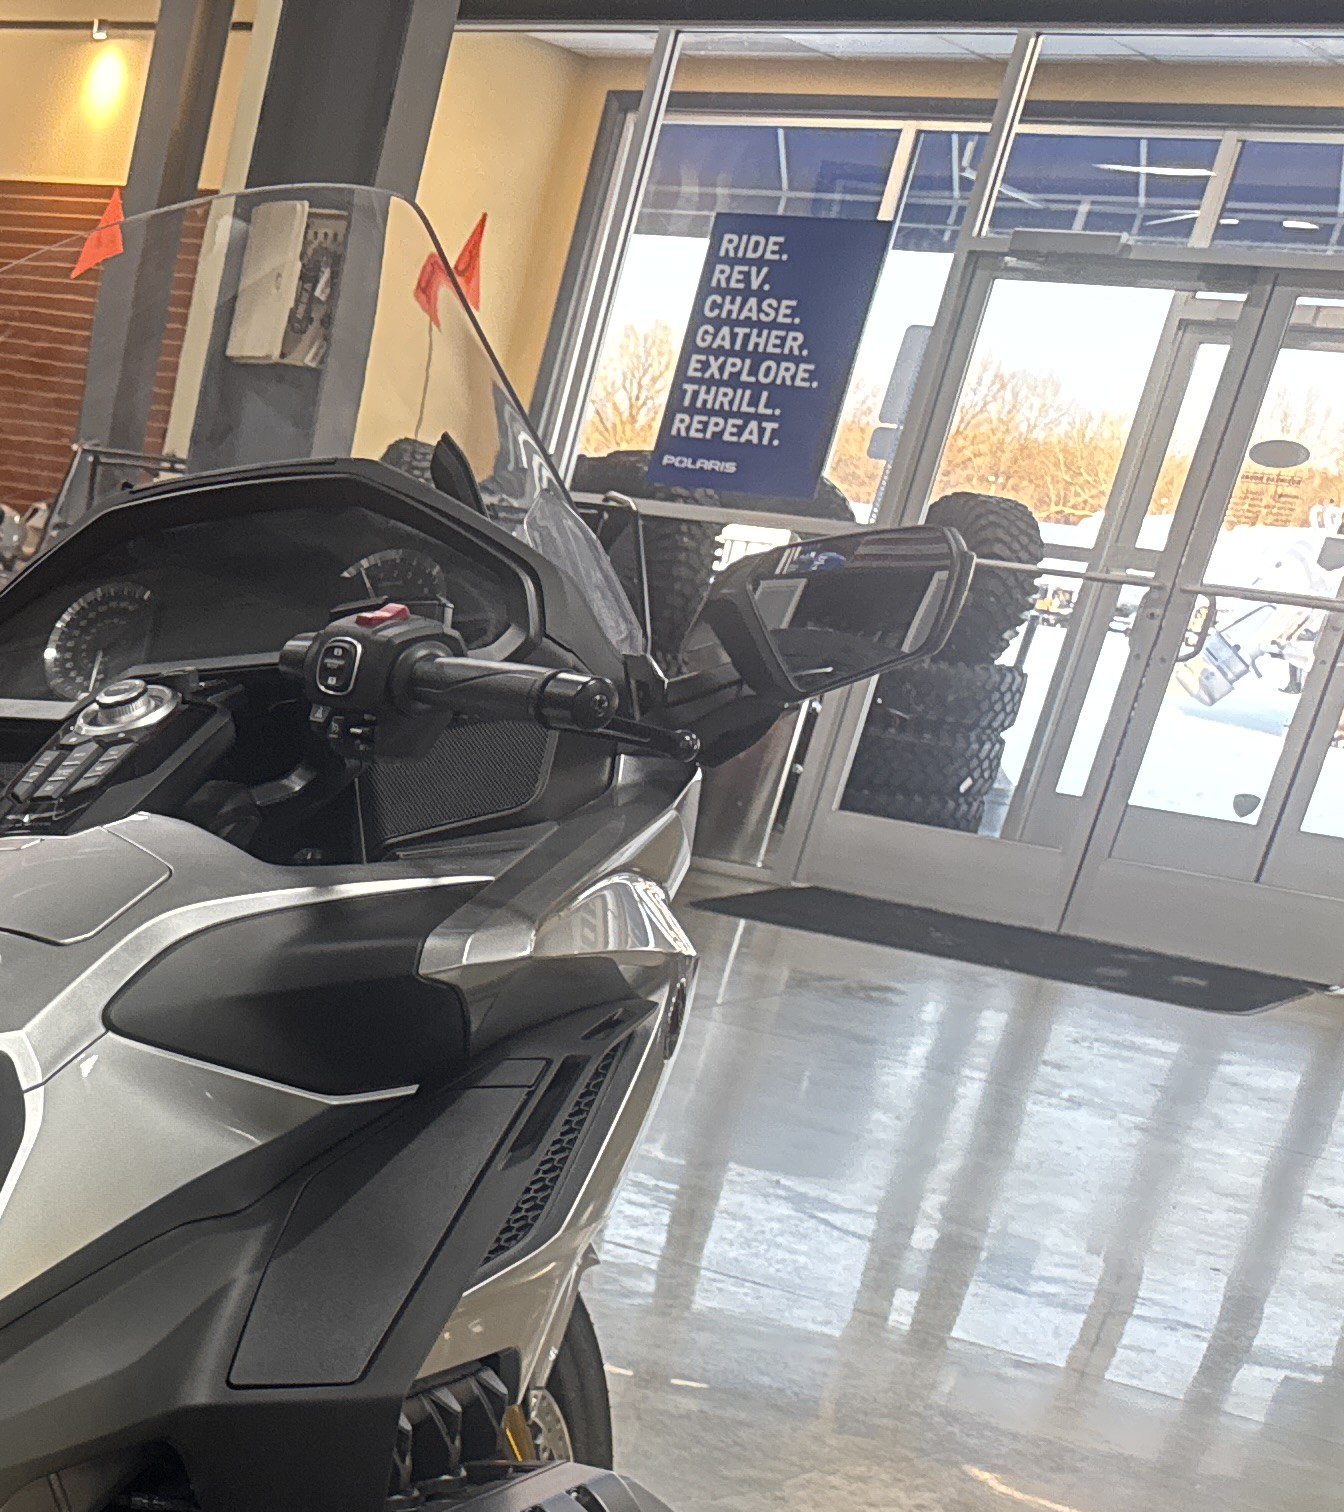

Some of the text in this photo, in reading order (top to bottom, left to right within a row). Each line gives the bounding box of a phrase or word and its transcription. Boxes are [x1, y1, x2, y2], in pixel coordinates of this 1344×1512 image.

[719, 233, 789, 262] RIDE.
[710, 263, 771, 292] REV.
[703, 294, 801, 325] CHASE.
[695, 324, 809, 357] GATHER.
[686, 354, 819, 388] EXPLORE.
[682, 383, 782, 416] THRILL.
[670, 413, 780, 447] REPEAT.
[662, 454, 738, 474] POLARIS
